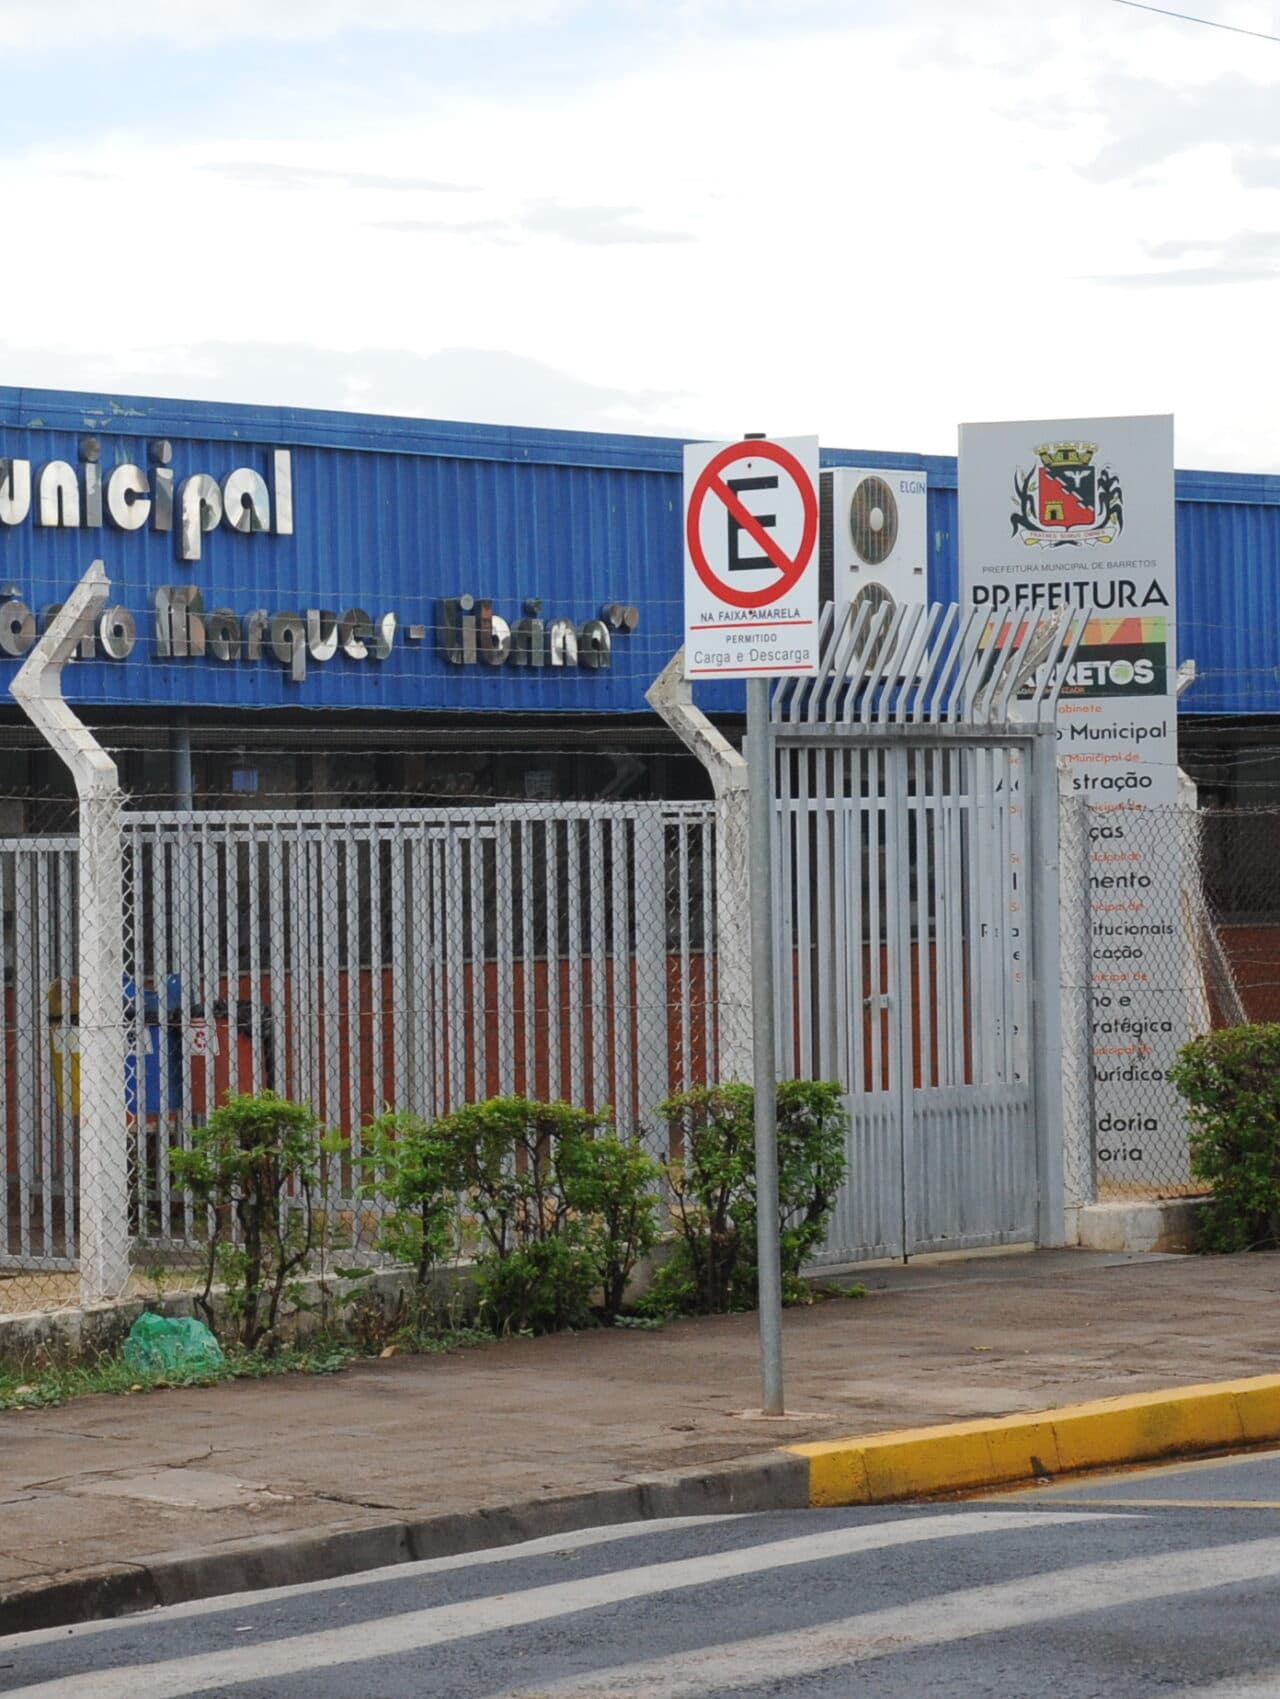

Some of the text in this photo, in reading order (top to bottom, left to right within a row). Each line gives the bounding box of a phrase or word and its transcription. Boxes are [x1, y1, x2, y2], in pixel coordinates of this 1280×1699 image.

[900, 480, 926, 495] ELGIN
[982, 559, 1157, 575] PREFEITURA MUNICIPAL DE BARRETOS
[701, 607, 801, 623] NA FAIXA AMARELA
[152, 583, 397, 682] Marques
[726, 633, 777, 644] PERMITIDO
[694, 648, 810, 667] Carga e Descarga
[1058, 703, 1103, 713] abinete
[1071, 721, 1167, 743] Municipal
